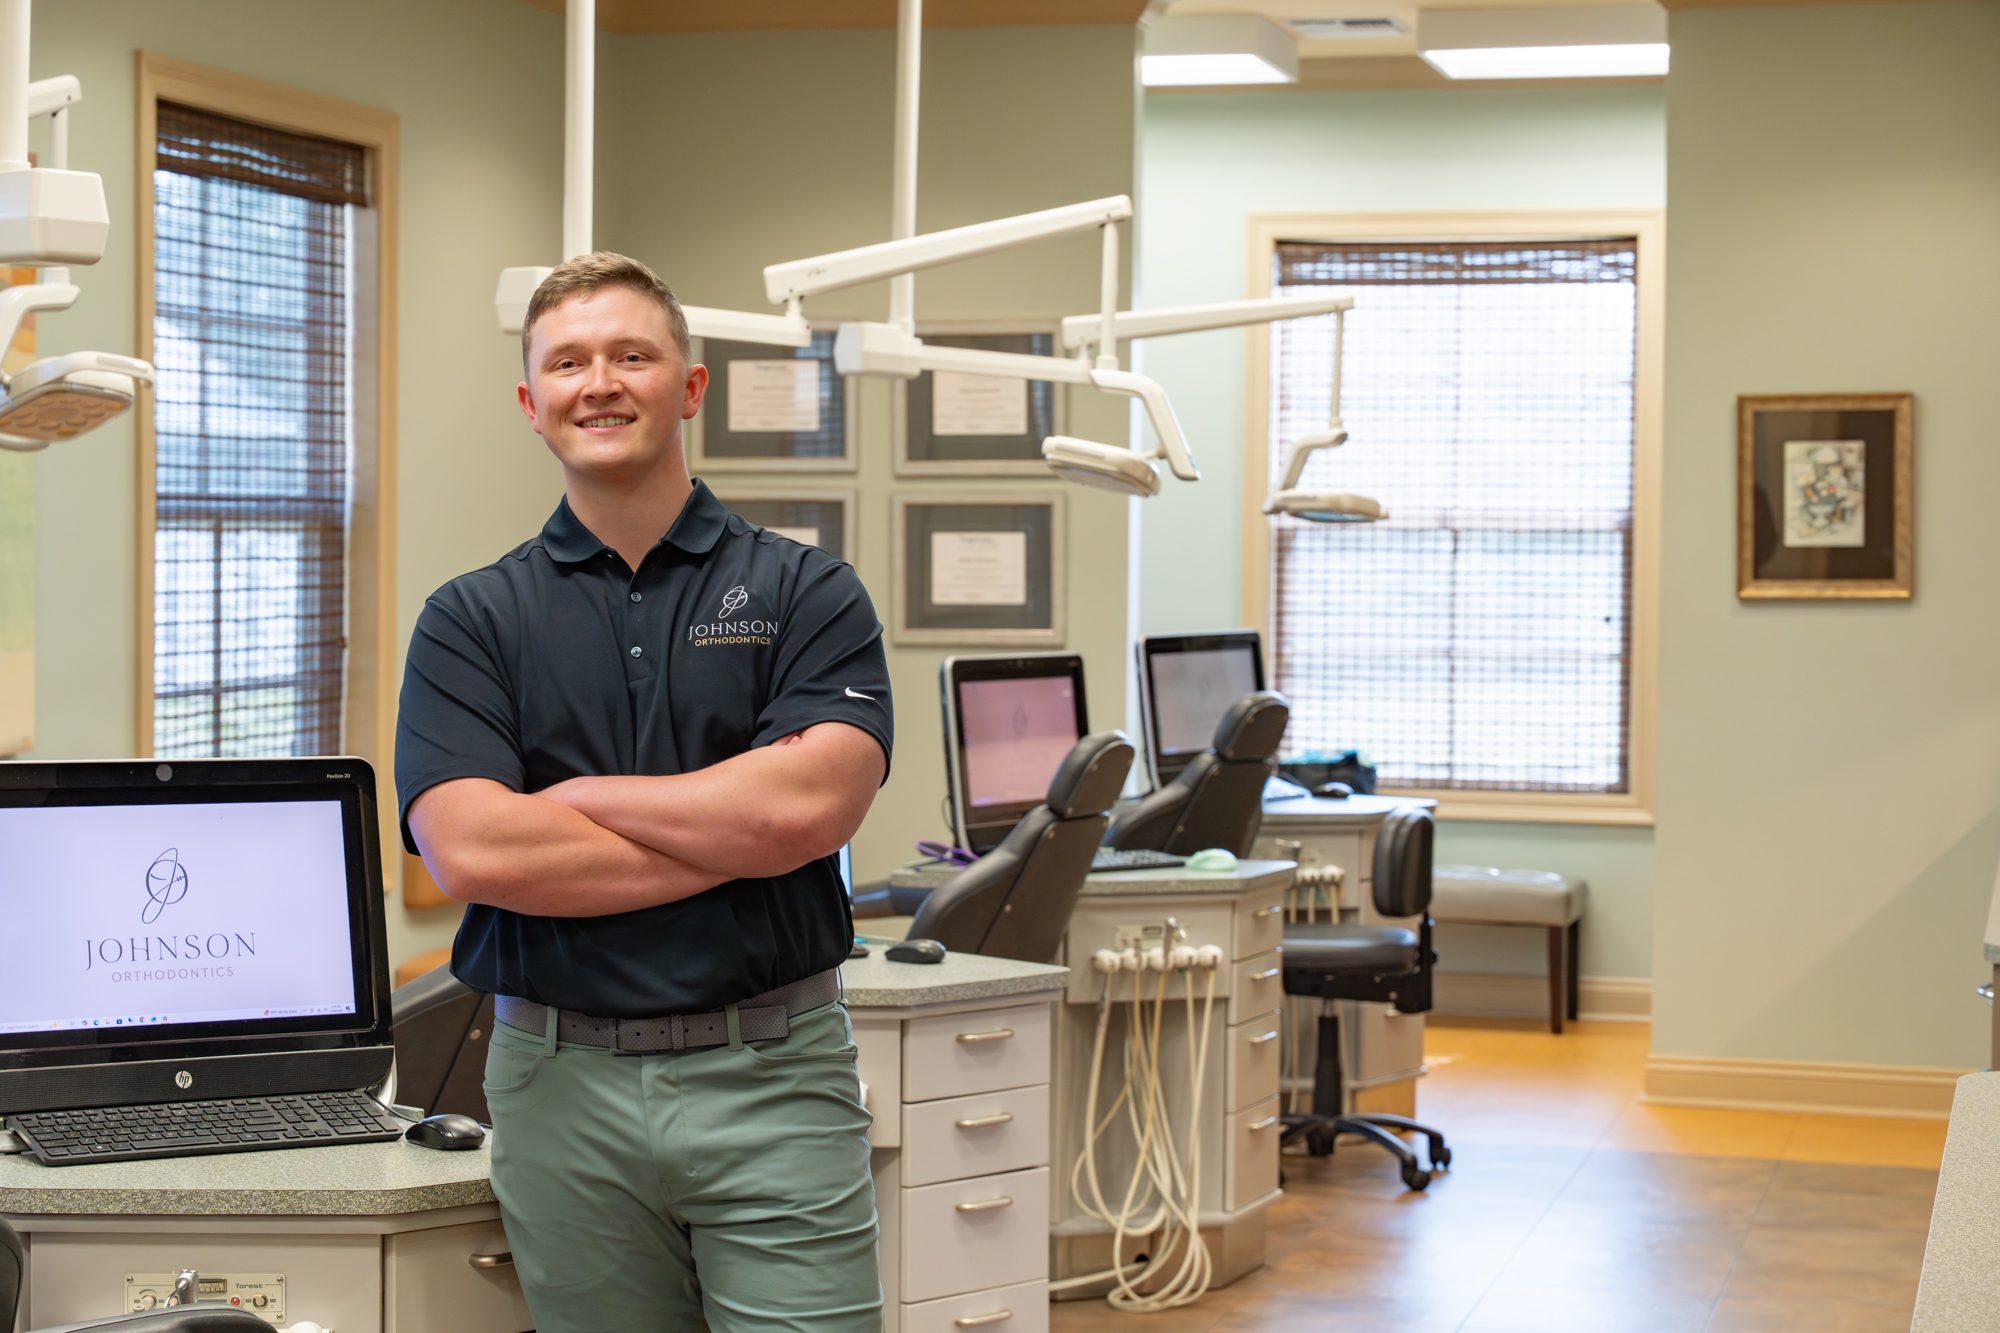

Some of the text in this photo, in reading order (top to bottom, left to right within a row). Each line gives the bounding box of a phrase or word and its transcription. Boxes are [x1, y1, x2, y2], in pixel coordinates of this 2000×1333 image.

[688, 620, 778, 641] JOHNSON
[694, 635, 771, 647] ORTHODONTICS
[85, 932, 256, 971] JOHNSON
[111, 966, 234, 983] ORTHODONTICS
[177, 1071, 191, 1088] hp
